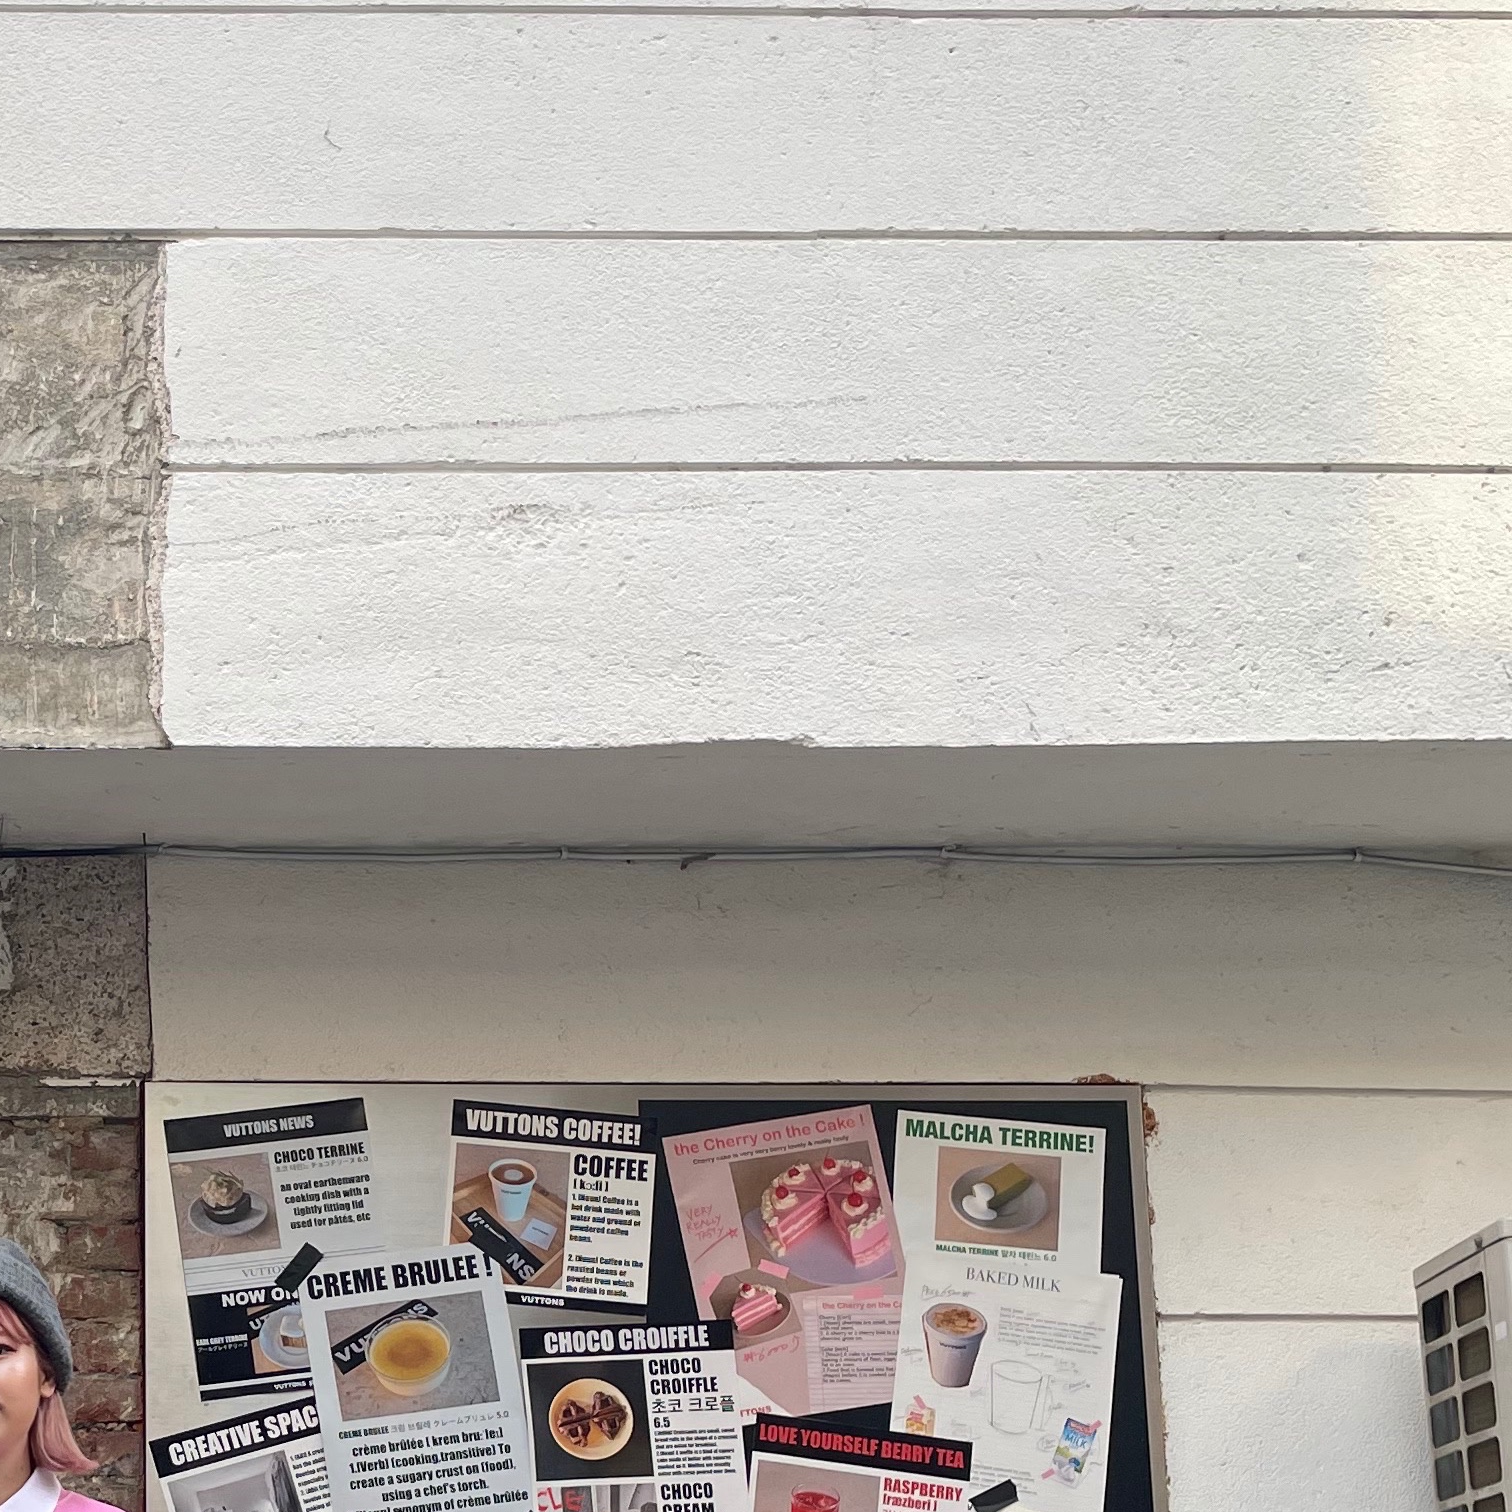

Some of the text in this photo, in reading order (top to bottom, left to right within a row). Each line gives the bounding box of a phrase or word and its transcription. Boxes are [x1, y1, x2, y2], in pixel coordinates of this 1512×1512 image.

[223, 1115, 314, 1138] VUTTONS NEWS
[466, 1108, 641, 1145] VUTTONS COFFEE!
[674, 1142, 698, 1156] the
[704, 1133, 758, 1150] Cherry
[763, 1131, 781, 1141] on
[787, 1126, 811, 1138] the
[815, 1117, 855, 1133] Cake
[905, 1119, 1094, 1153] MALCHA TERRINE!
[274, 1142, 365, 1164] CHOCO TERRINE
[573, 1154, 649, 1182] COFFEE
[280, 1174, 370, 1192] an oval earthenware
[285, 1193, 320, 1204] cooking
[322, 1190, 341, 1200] dish
[343, 1188, 362, 1197] with
[294, 1200, 364, 1216] tightly fitting lid
[291, 1219, 312, 1229] used
[314, 1218, 326, 1226] for
[356, 1213, 370, 1221] etc
[936, 1244, 966, 1253] MALCHA
[306, 1266, 388, 1300] CREME
[392, 1255, 479, 1289] BRULEE
[966, 1267, 1061, 1292] BAKED MILK
[222, 1289, 265, 1307] NOW
[521, 1295, 565, 1306] VUTTONS
[544, 1325, 709, 1354] CHOCO CROIFFLE
[649, 1357, 701, 1375] CHOCO
[651, 1377, 718, 1395] CROIFFLE
[652, 1398, 683, 1413] 초코
[689, 1395, 735, 1413] 크로플
[654, 1417, 671, 1429] 6.5
[169, 1405, 319, 1466] CREATIVE SPAC
[352, 1443, 387, 1456] crème
[499, 1443, 511, 1454] To
[759, 1423, 965, 1468] LOVE YOURSELF BERRY TEA
[350, 1465, 479, 1490] create a sugary crust on
[382, 1489, 412, 1502] using
[415, 1488, 421, 1498] a
[459, 1479, 489, 1492] torch.
[661, 1482, 713, 1500] CHOCO
[884, 1477, 963, 1502] RASPBERRY
[444, 1499, 455, 1510] of
[457, 1495, 490, 1509] crème
